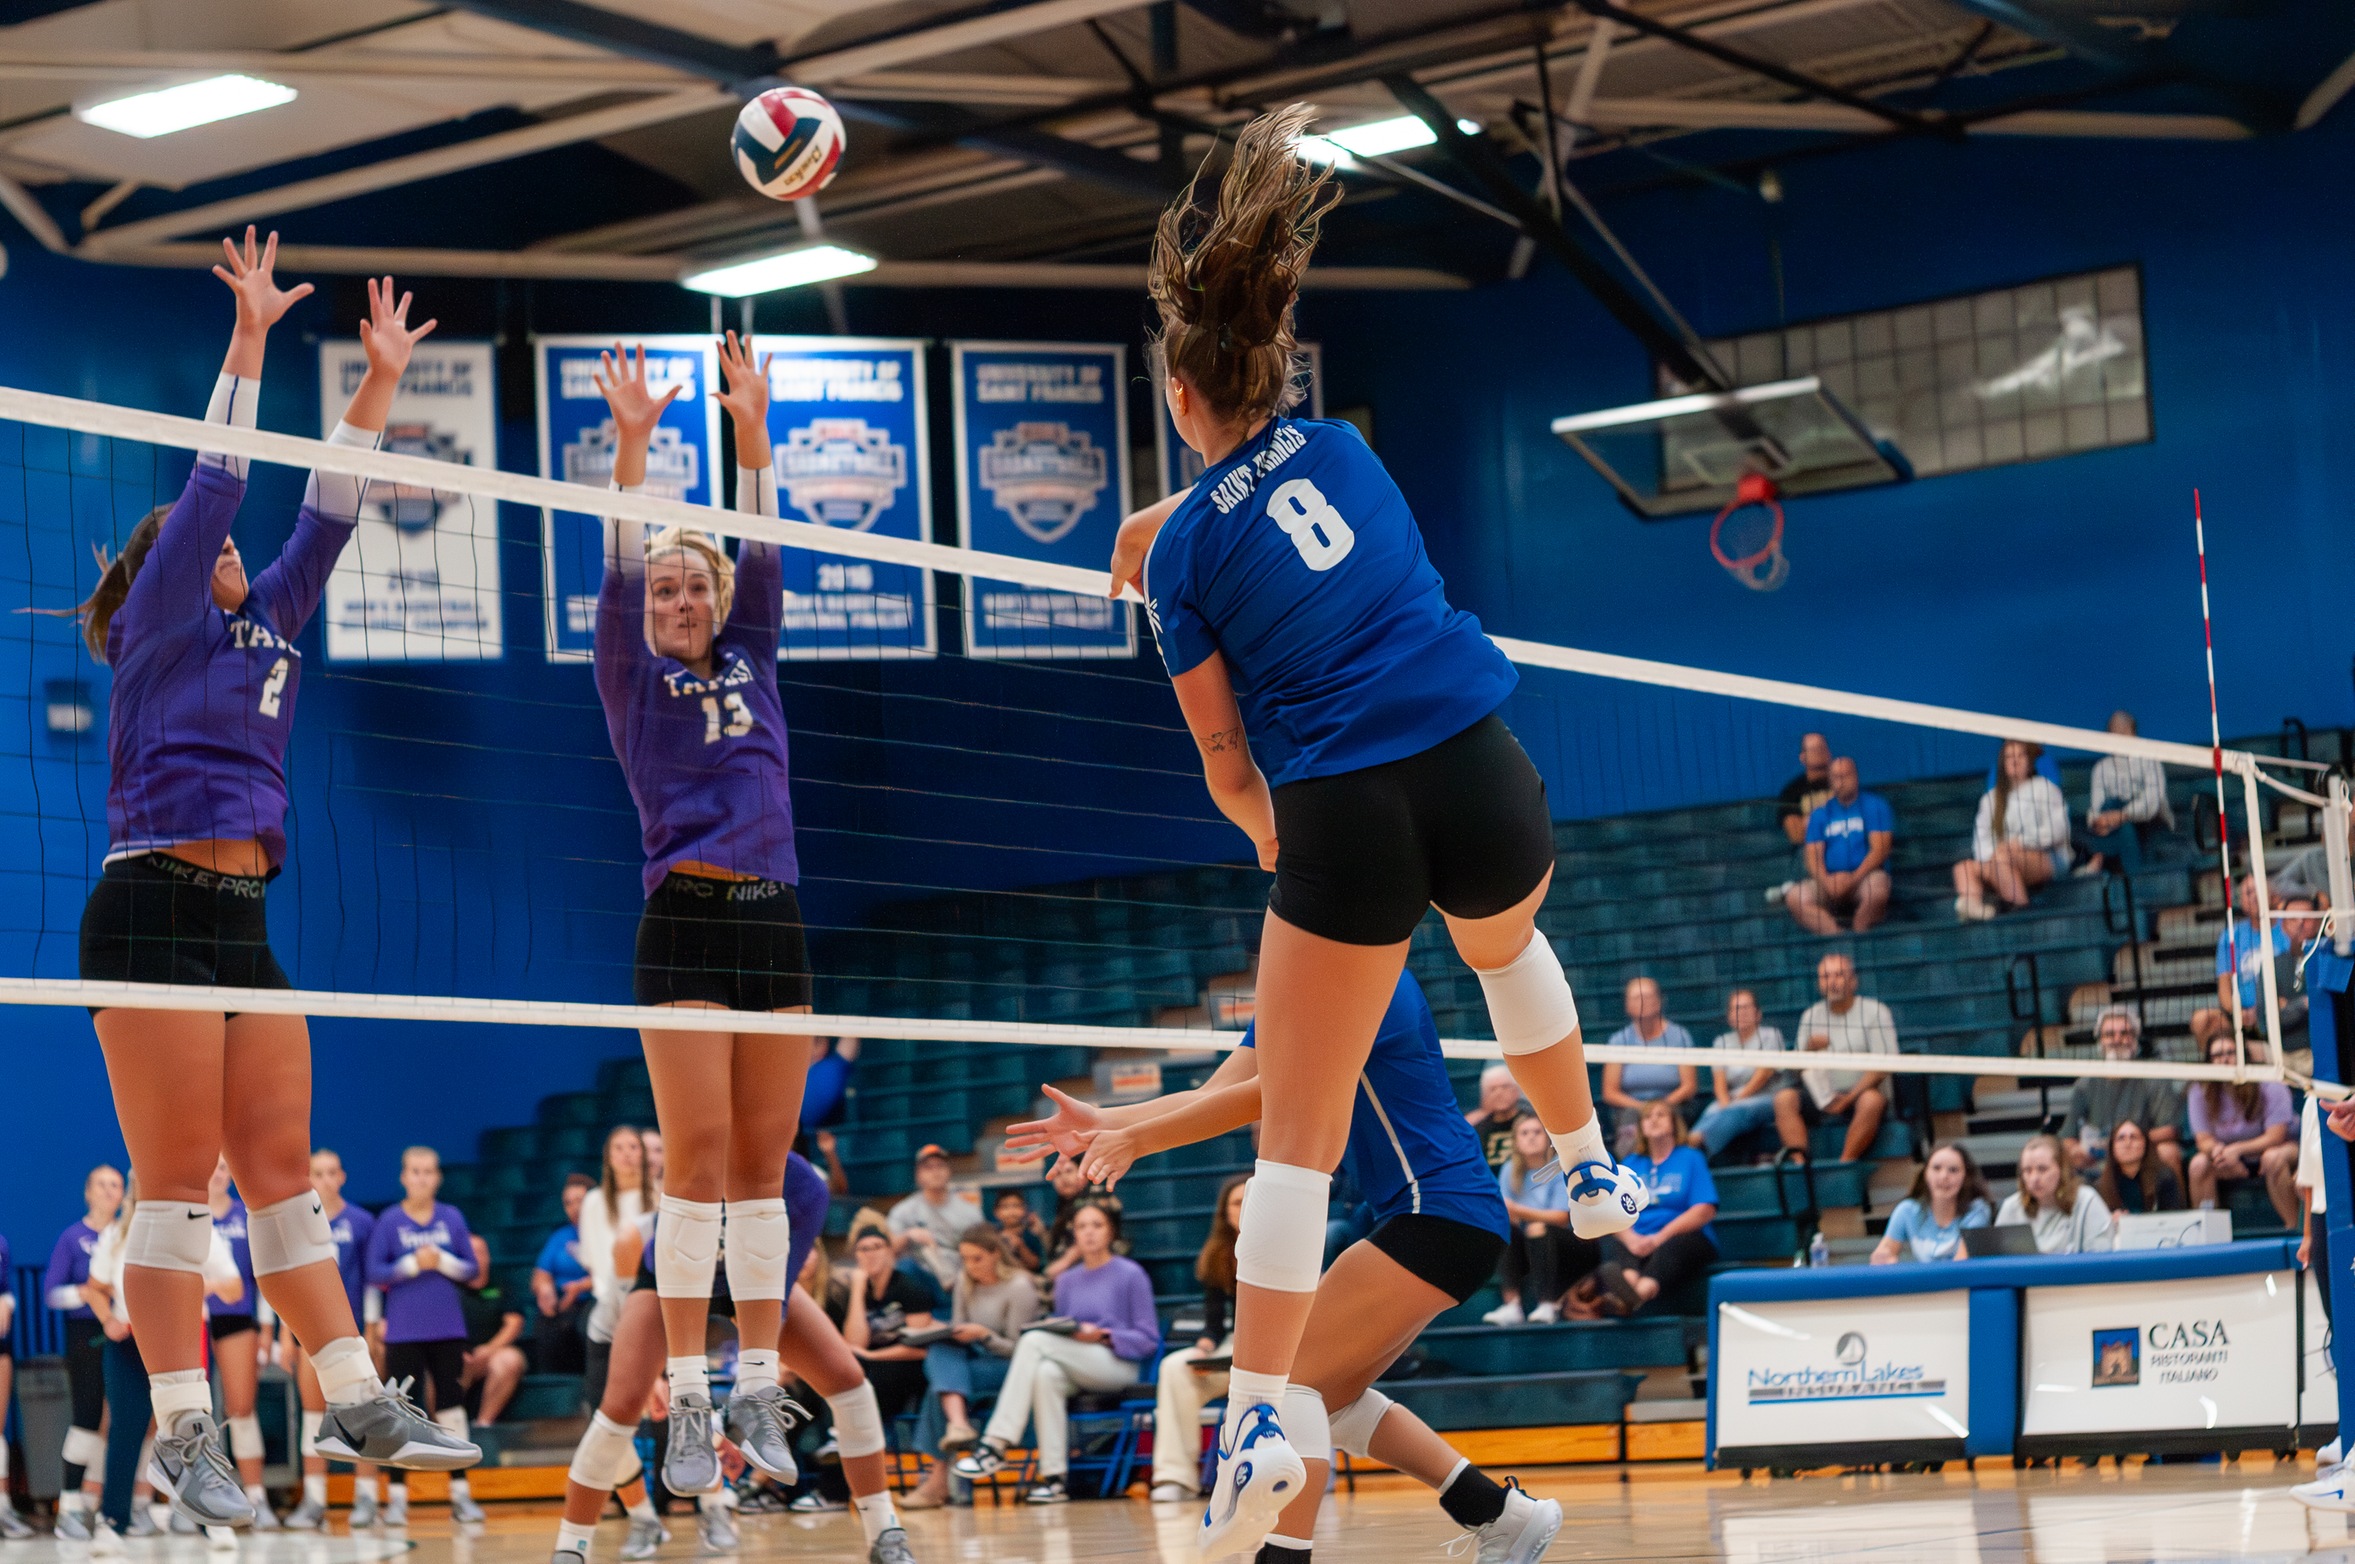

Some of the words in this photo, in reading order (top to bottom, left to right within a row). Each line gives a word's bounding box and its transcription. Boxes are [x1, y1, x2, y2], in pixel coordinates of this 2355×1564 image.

[1210, 464, 1255, 514] SAINT
[1266, 478, 1355, 571] 8
[258, 657, 288, 719] 2
[701, 691, 753, 744] 13
[726, 881, 779, 901] NIKE
[2147, 1318, 2229, 1350] CASA
